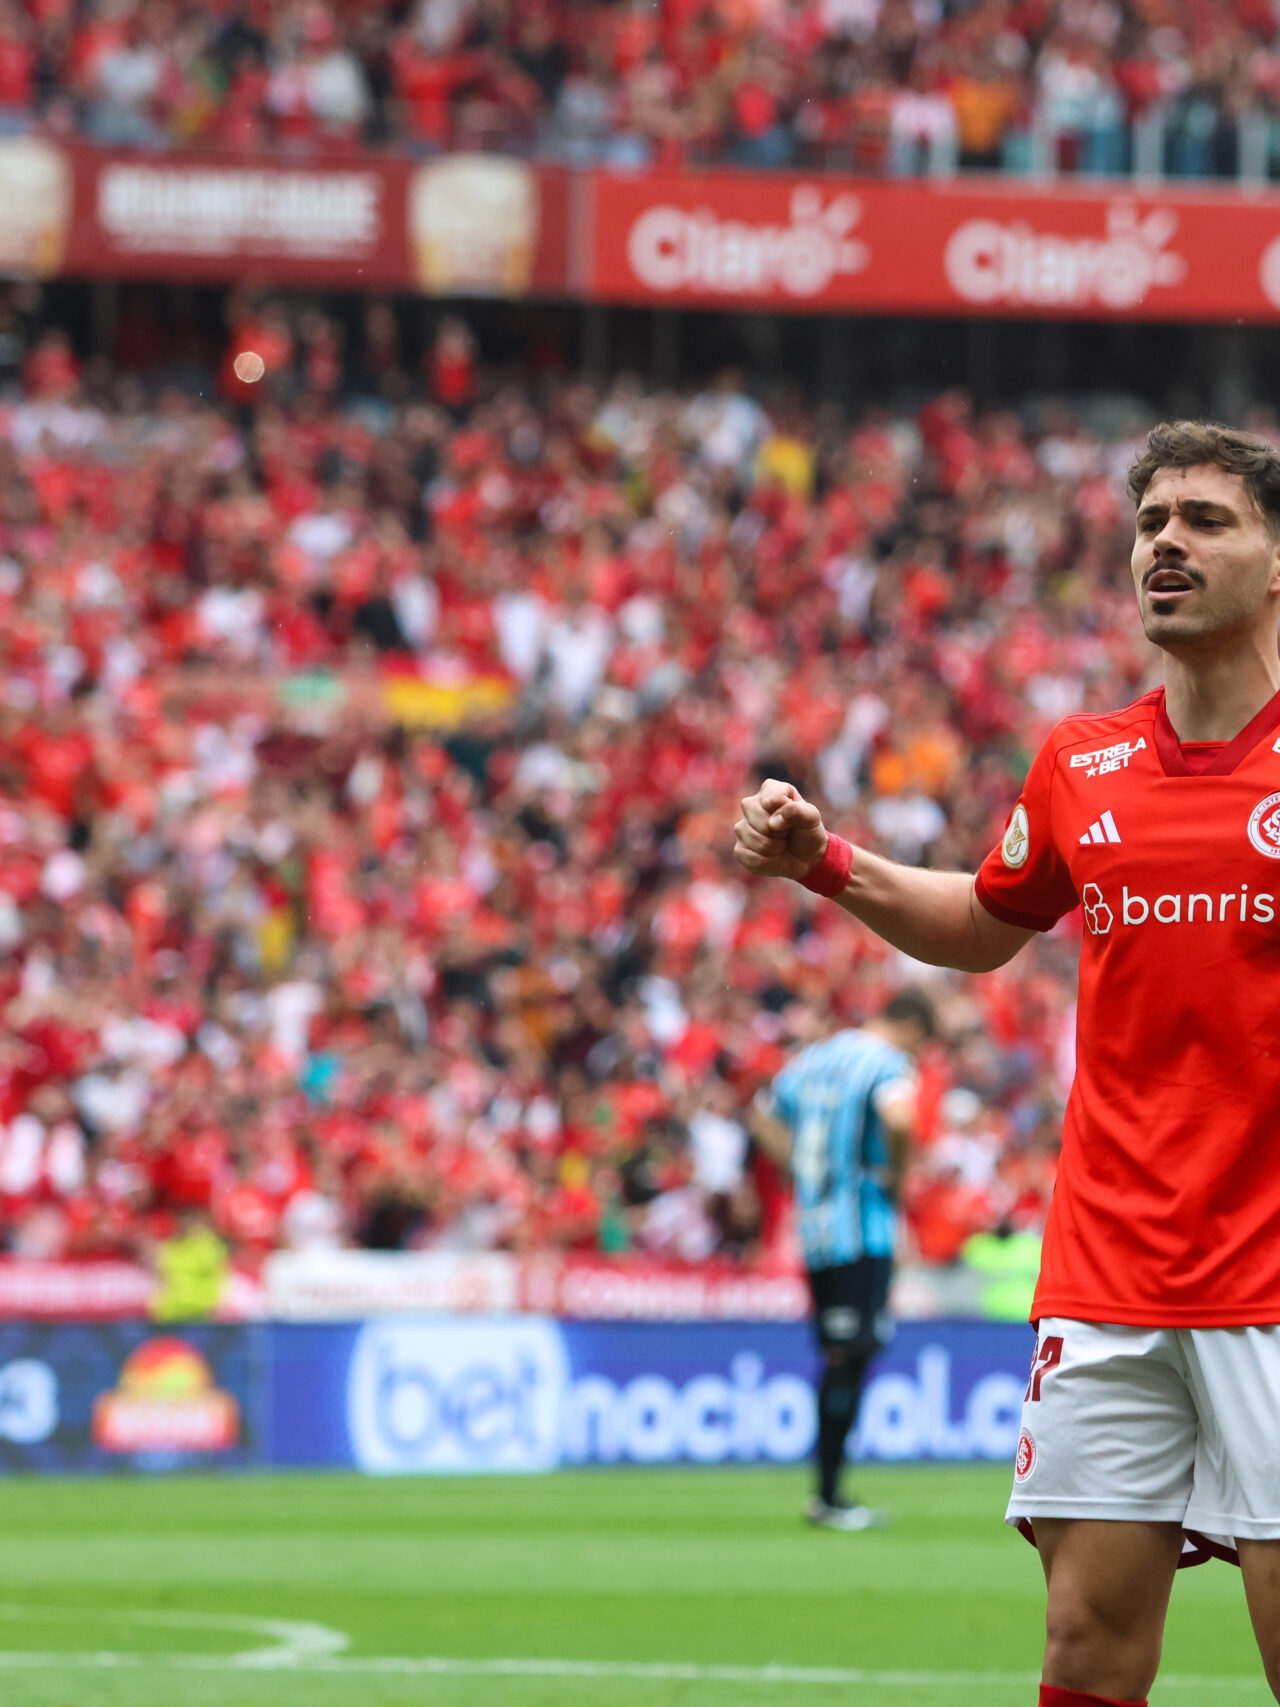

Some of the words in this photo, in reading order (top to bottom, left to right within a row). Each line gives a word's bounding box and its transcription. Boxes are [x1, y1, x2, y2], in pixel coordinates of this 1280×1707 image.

[628, 203, 838, 298] Claro
[944, 217, 1152, 310] Claro
[1069, 736, 1147, 768] ESTRELA
[1098, 752, 1133, 775] BET
[1024, 1335, 1065, 1403] 7
